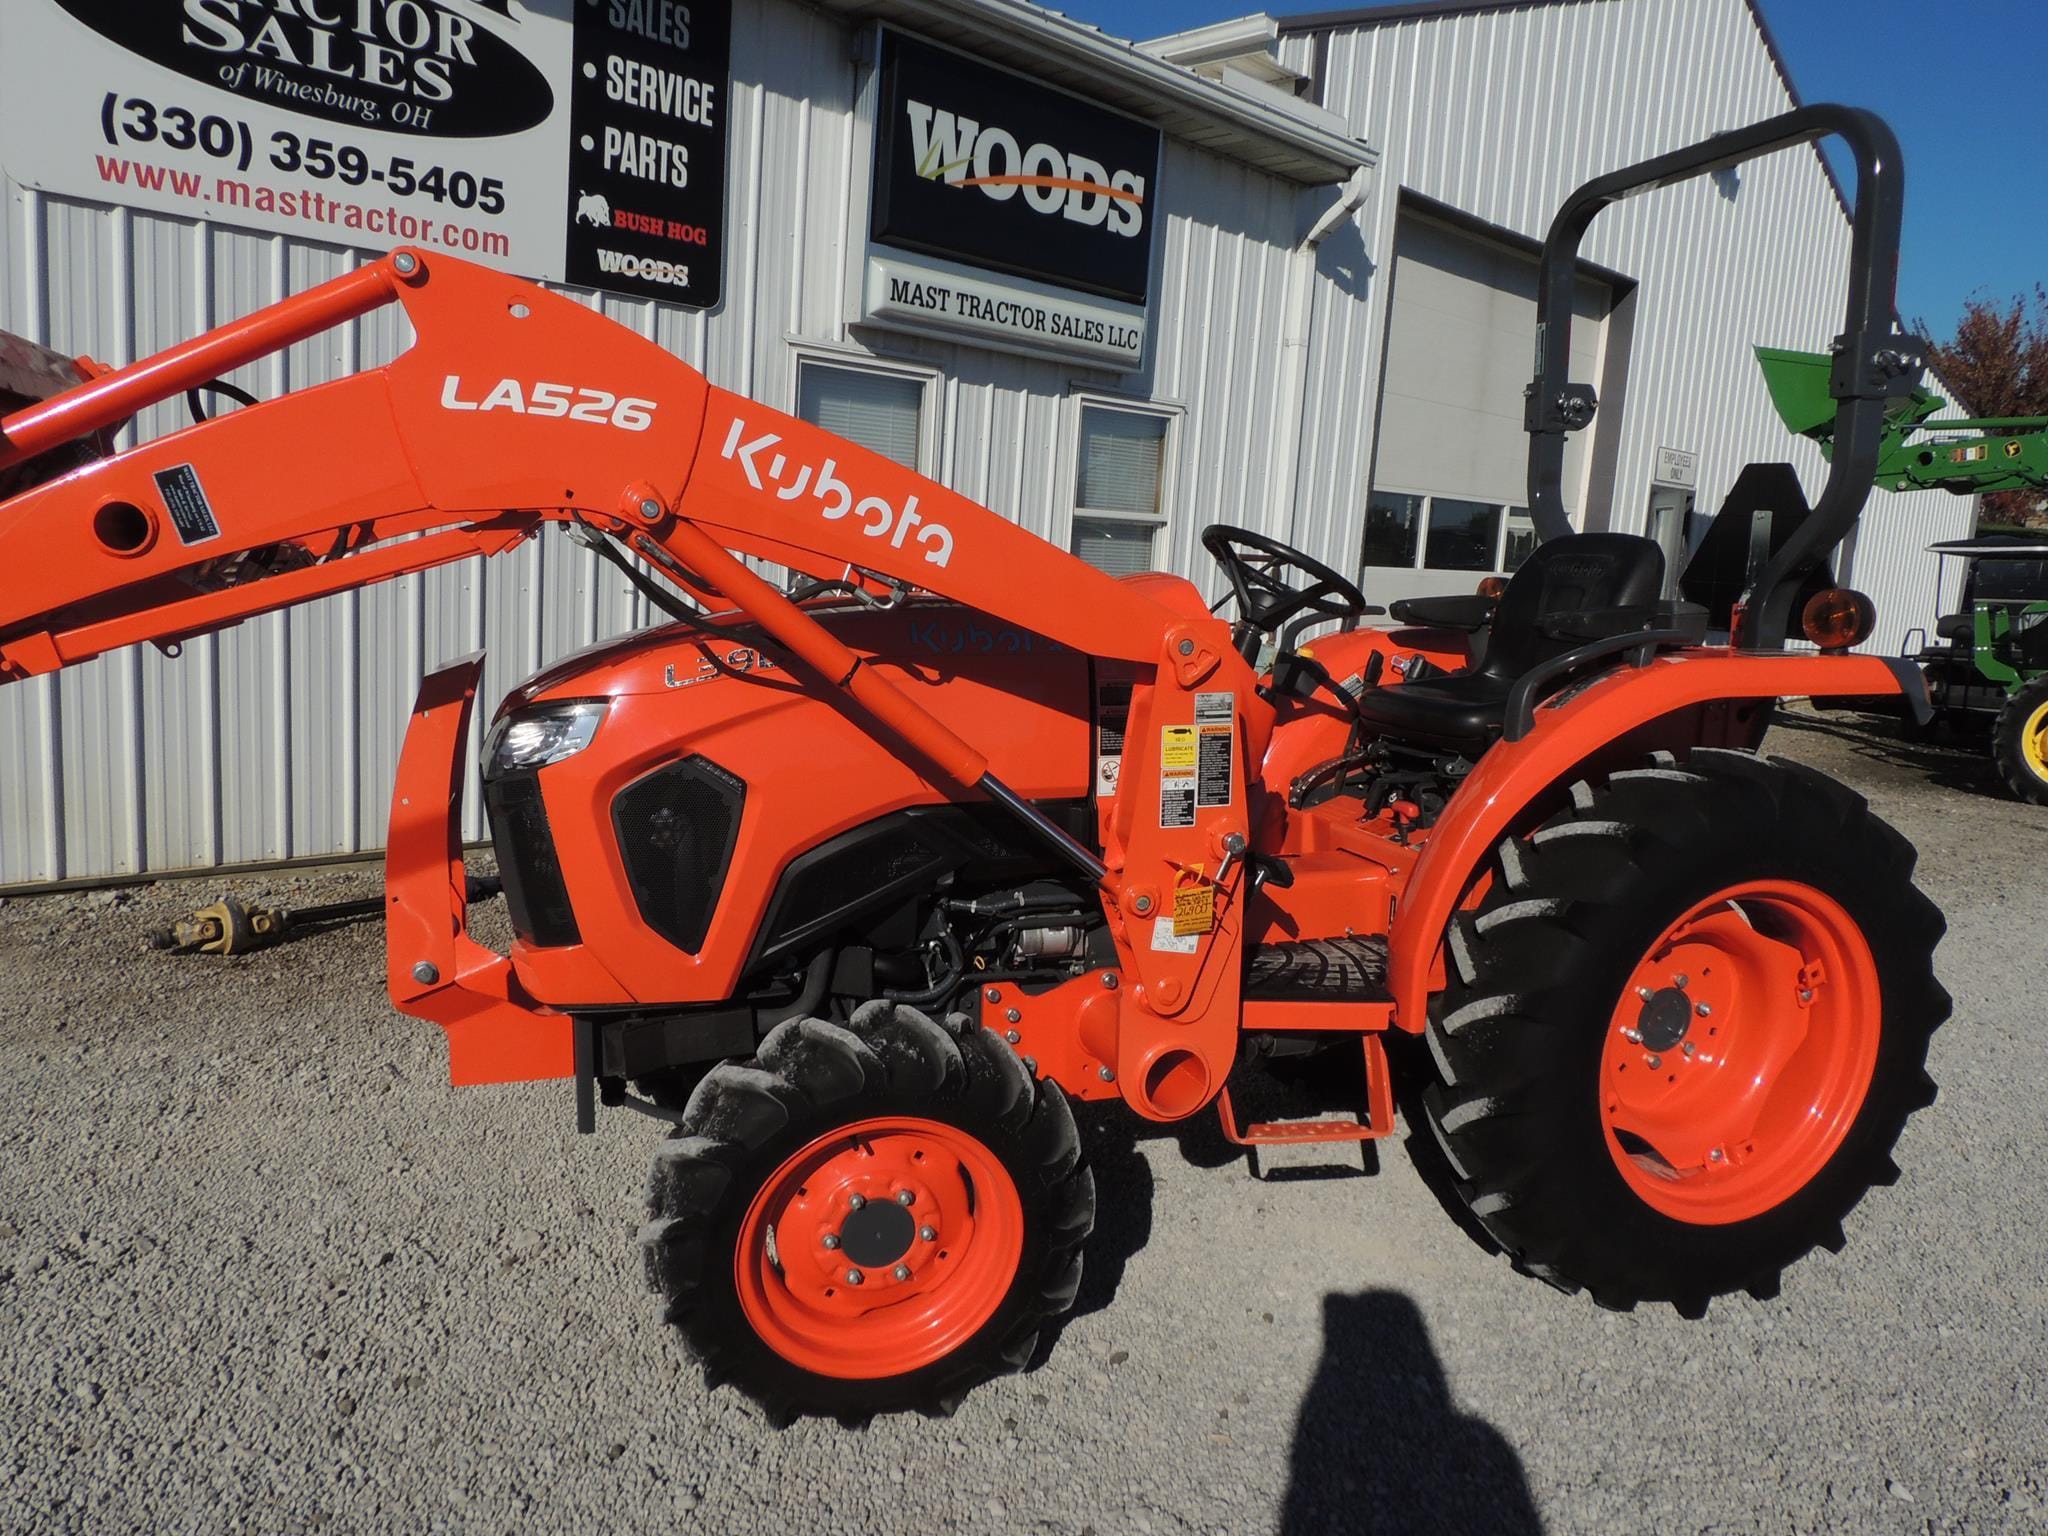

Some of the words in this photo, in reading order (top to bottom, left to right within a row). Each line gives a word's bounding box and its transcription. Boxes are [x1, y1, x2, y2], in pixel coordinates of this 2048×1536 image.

[183, 0, 452, 101] SALES
[608, 0, 691, 49] SALES
[219, 62, 251, 88] of
[253, 66, 382, 121] Winesburg,
[391, 102, 434, 129] OH
[606, 54, 715, 127] SERVICE
[101, 92, 254, 172] (330)
[269, 130, 506, 215] 359-5405
[604, 126, 689, 188] PARTS
[906, 99, 1146, 238] WOODS
[95, 154, 511, 258] www.masttractor.com
[614, 209, 665, 237] BUSH
[667, 221, 708, 246] HOG
[596, 248, 689, 287] WOODS
[890, 277, 950, 312] MAST
[956, 291, 1046, 333] TRACTOR
[1050, 313, 1104, 344] SALES
[1107, 325, 1139, 350] LLC
[440, 375, 658, 432] LA526
[1664, 450, 1692, 468] EMPLOYEES
[1671, 467, 1683, 480] ONLY
[720, 417, 955, 569] Kubota
